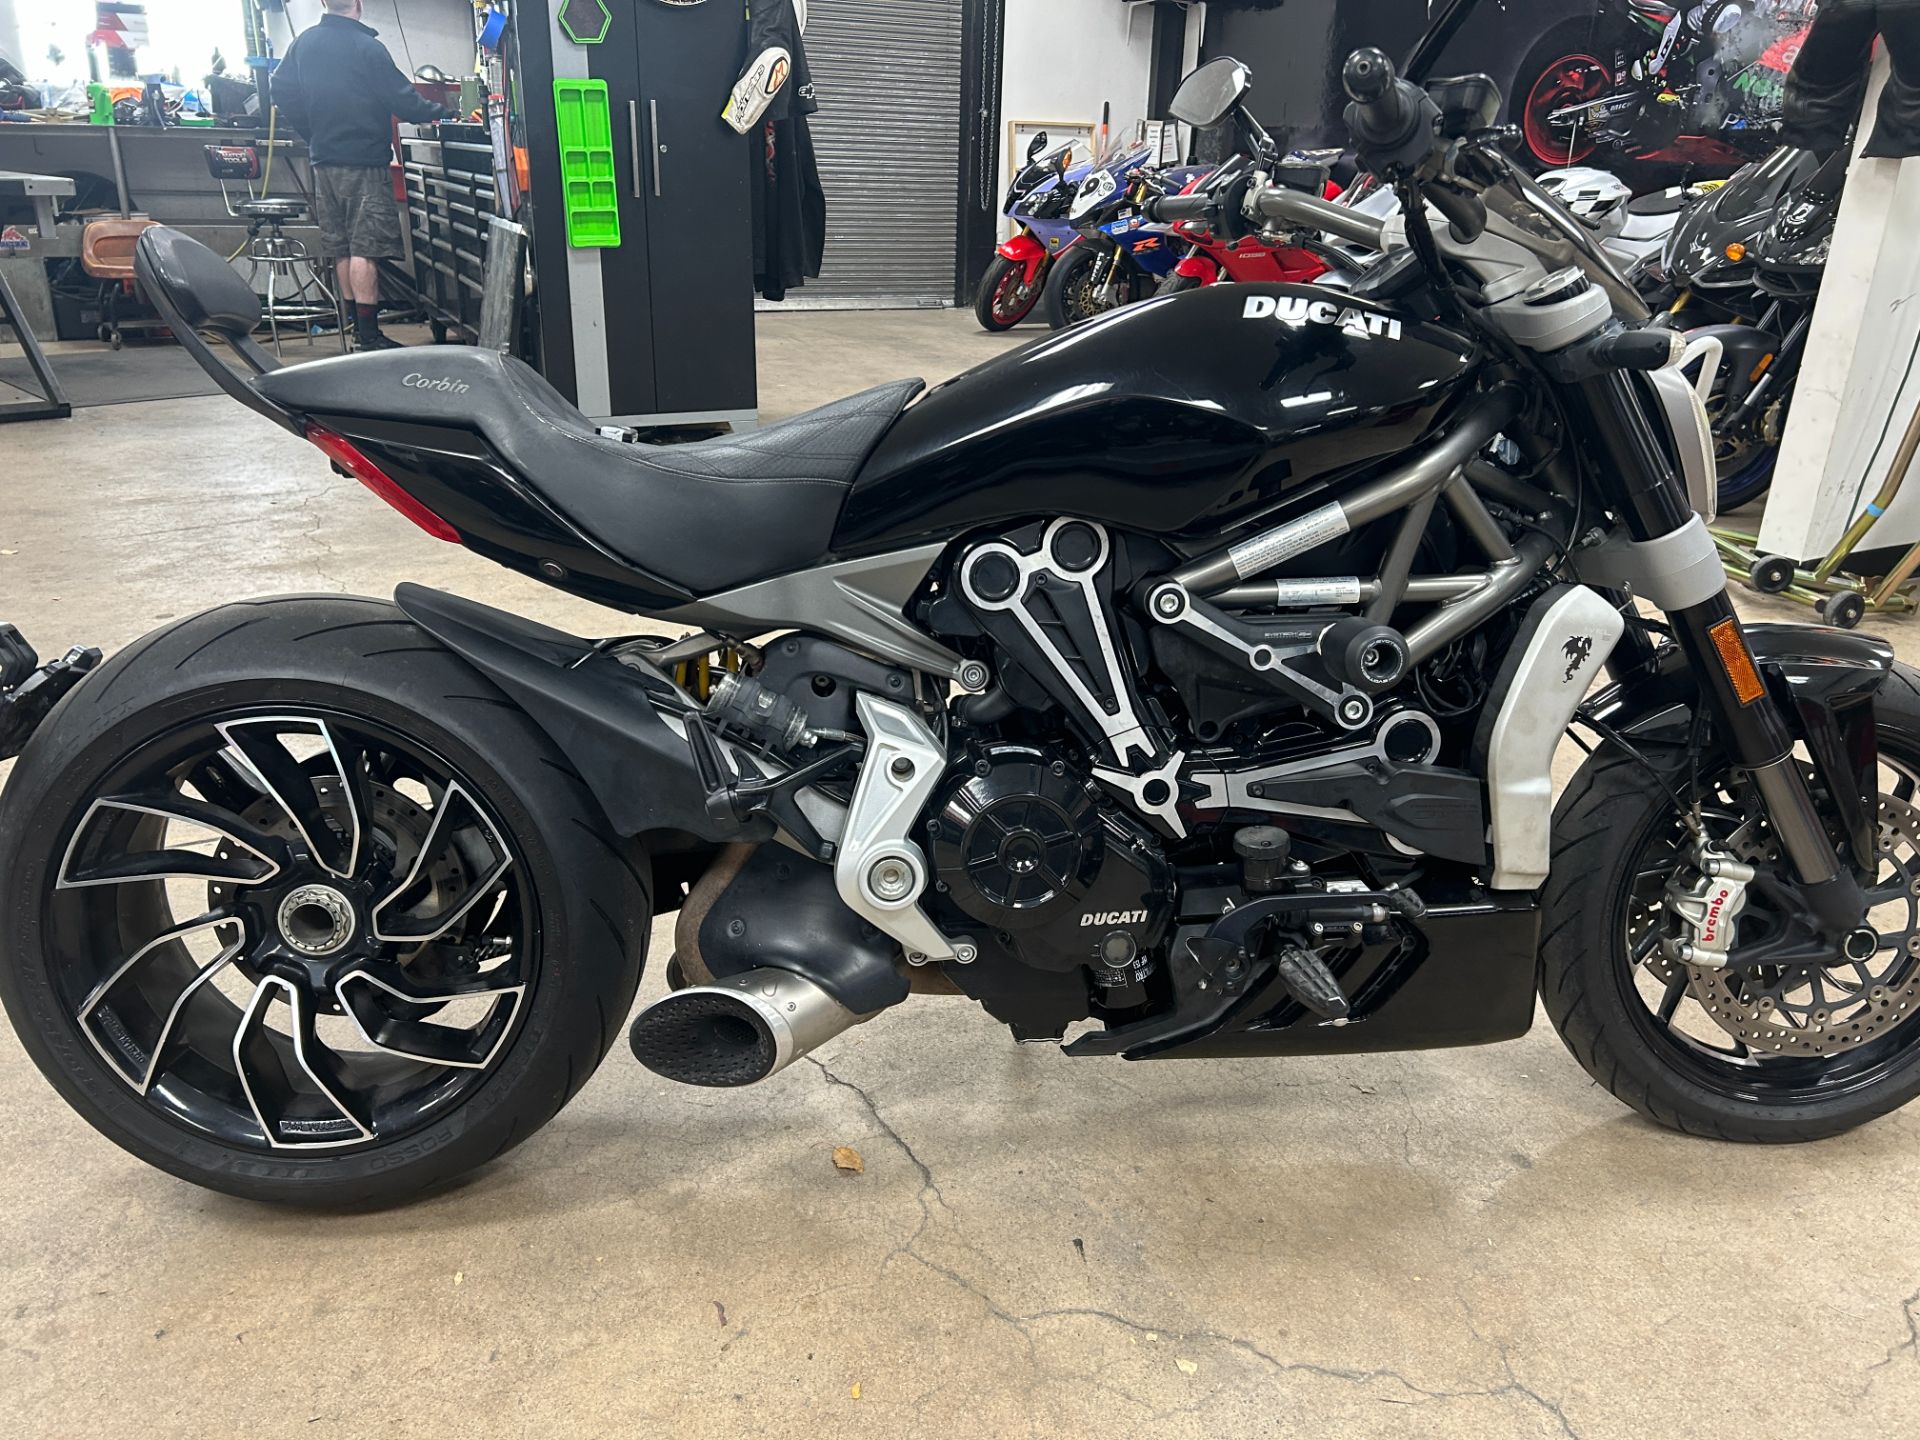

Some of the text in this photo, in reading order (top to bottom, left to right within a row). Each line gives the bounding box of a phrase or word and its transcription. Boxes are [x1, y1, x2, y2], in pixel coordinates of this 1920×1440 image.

[1242, 295, 1402, 341] DUCATI
[401, 372, 471, 394] Corbin
[1080, 910, 1148, 927] DUCATI
[1701, 889, 1728, 942] brembo
[370, 1128, 455, 1170] ROSSO
